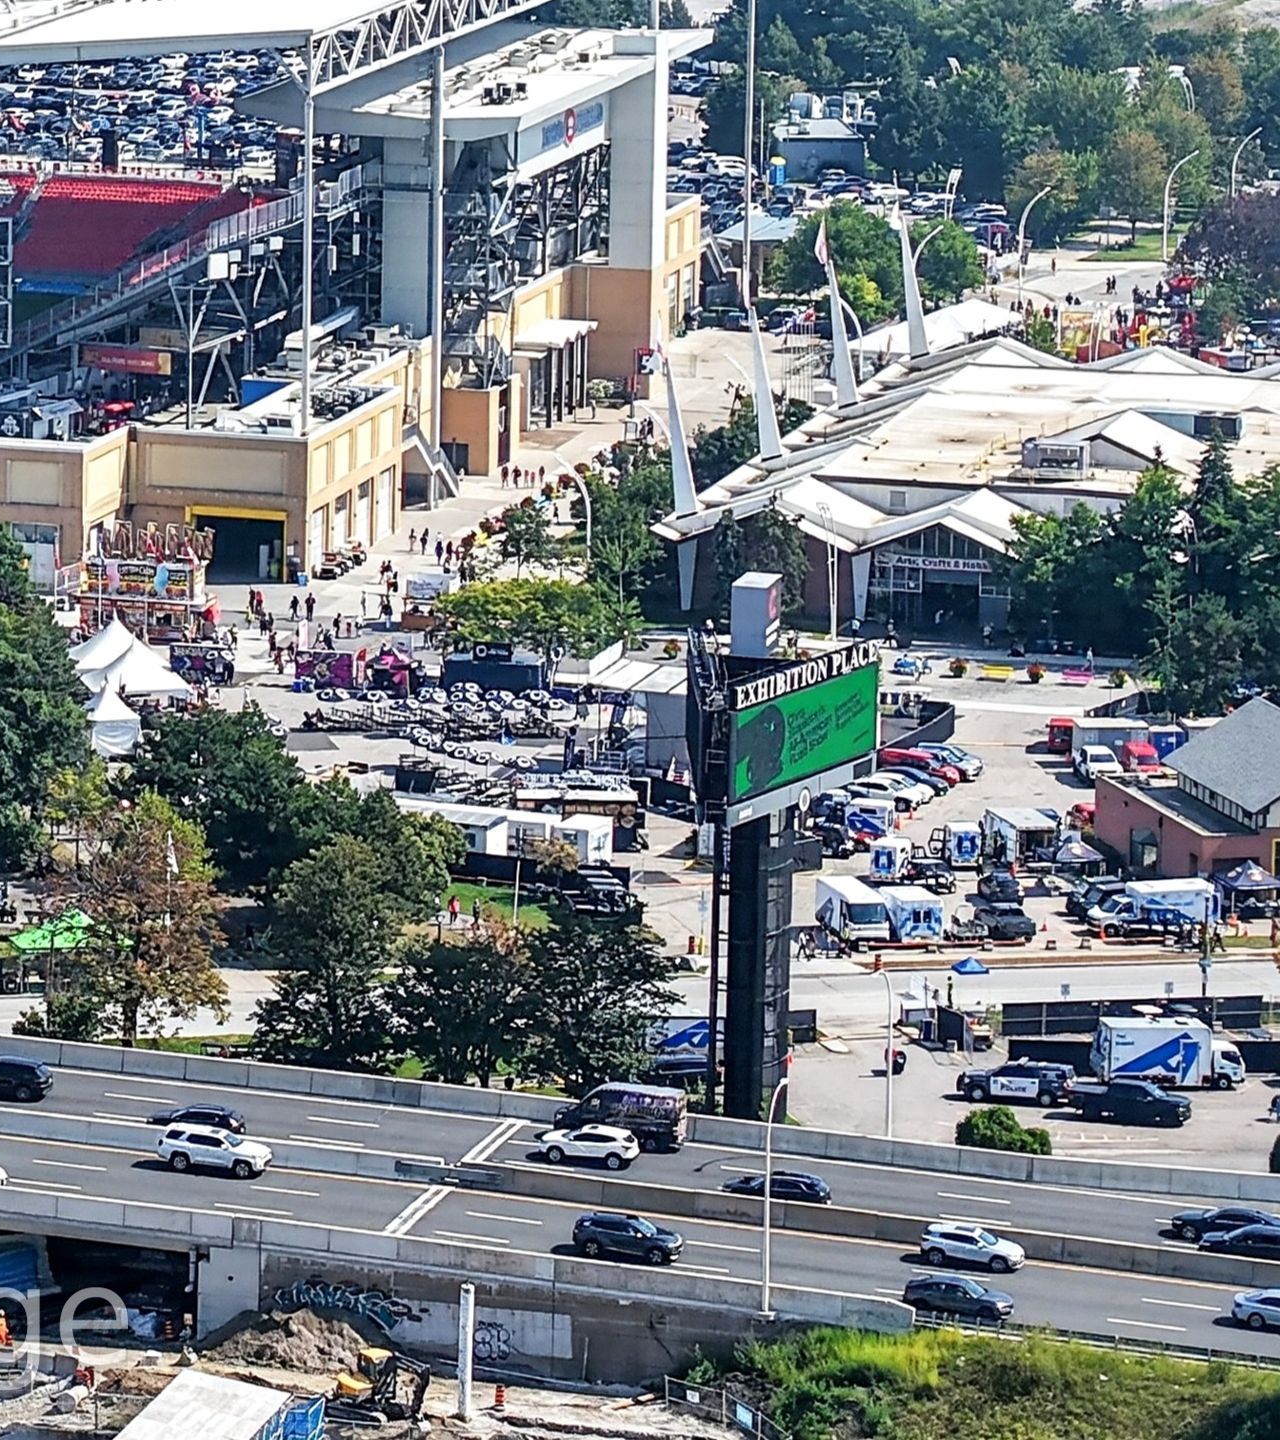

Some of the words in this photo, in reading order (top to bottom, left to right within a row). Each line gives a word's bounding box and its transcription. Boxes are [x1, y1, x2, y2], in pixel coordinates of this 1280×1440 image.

[992, 232, 1002, 249] 4
[735, 655, 828, 709] EXHIBITION
[831, 640, 880, 674] PLACE
[1000, 1083, 1027, 1094] POLICE
